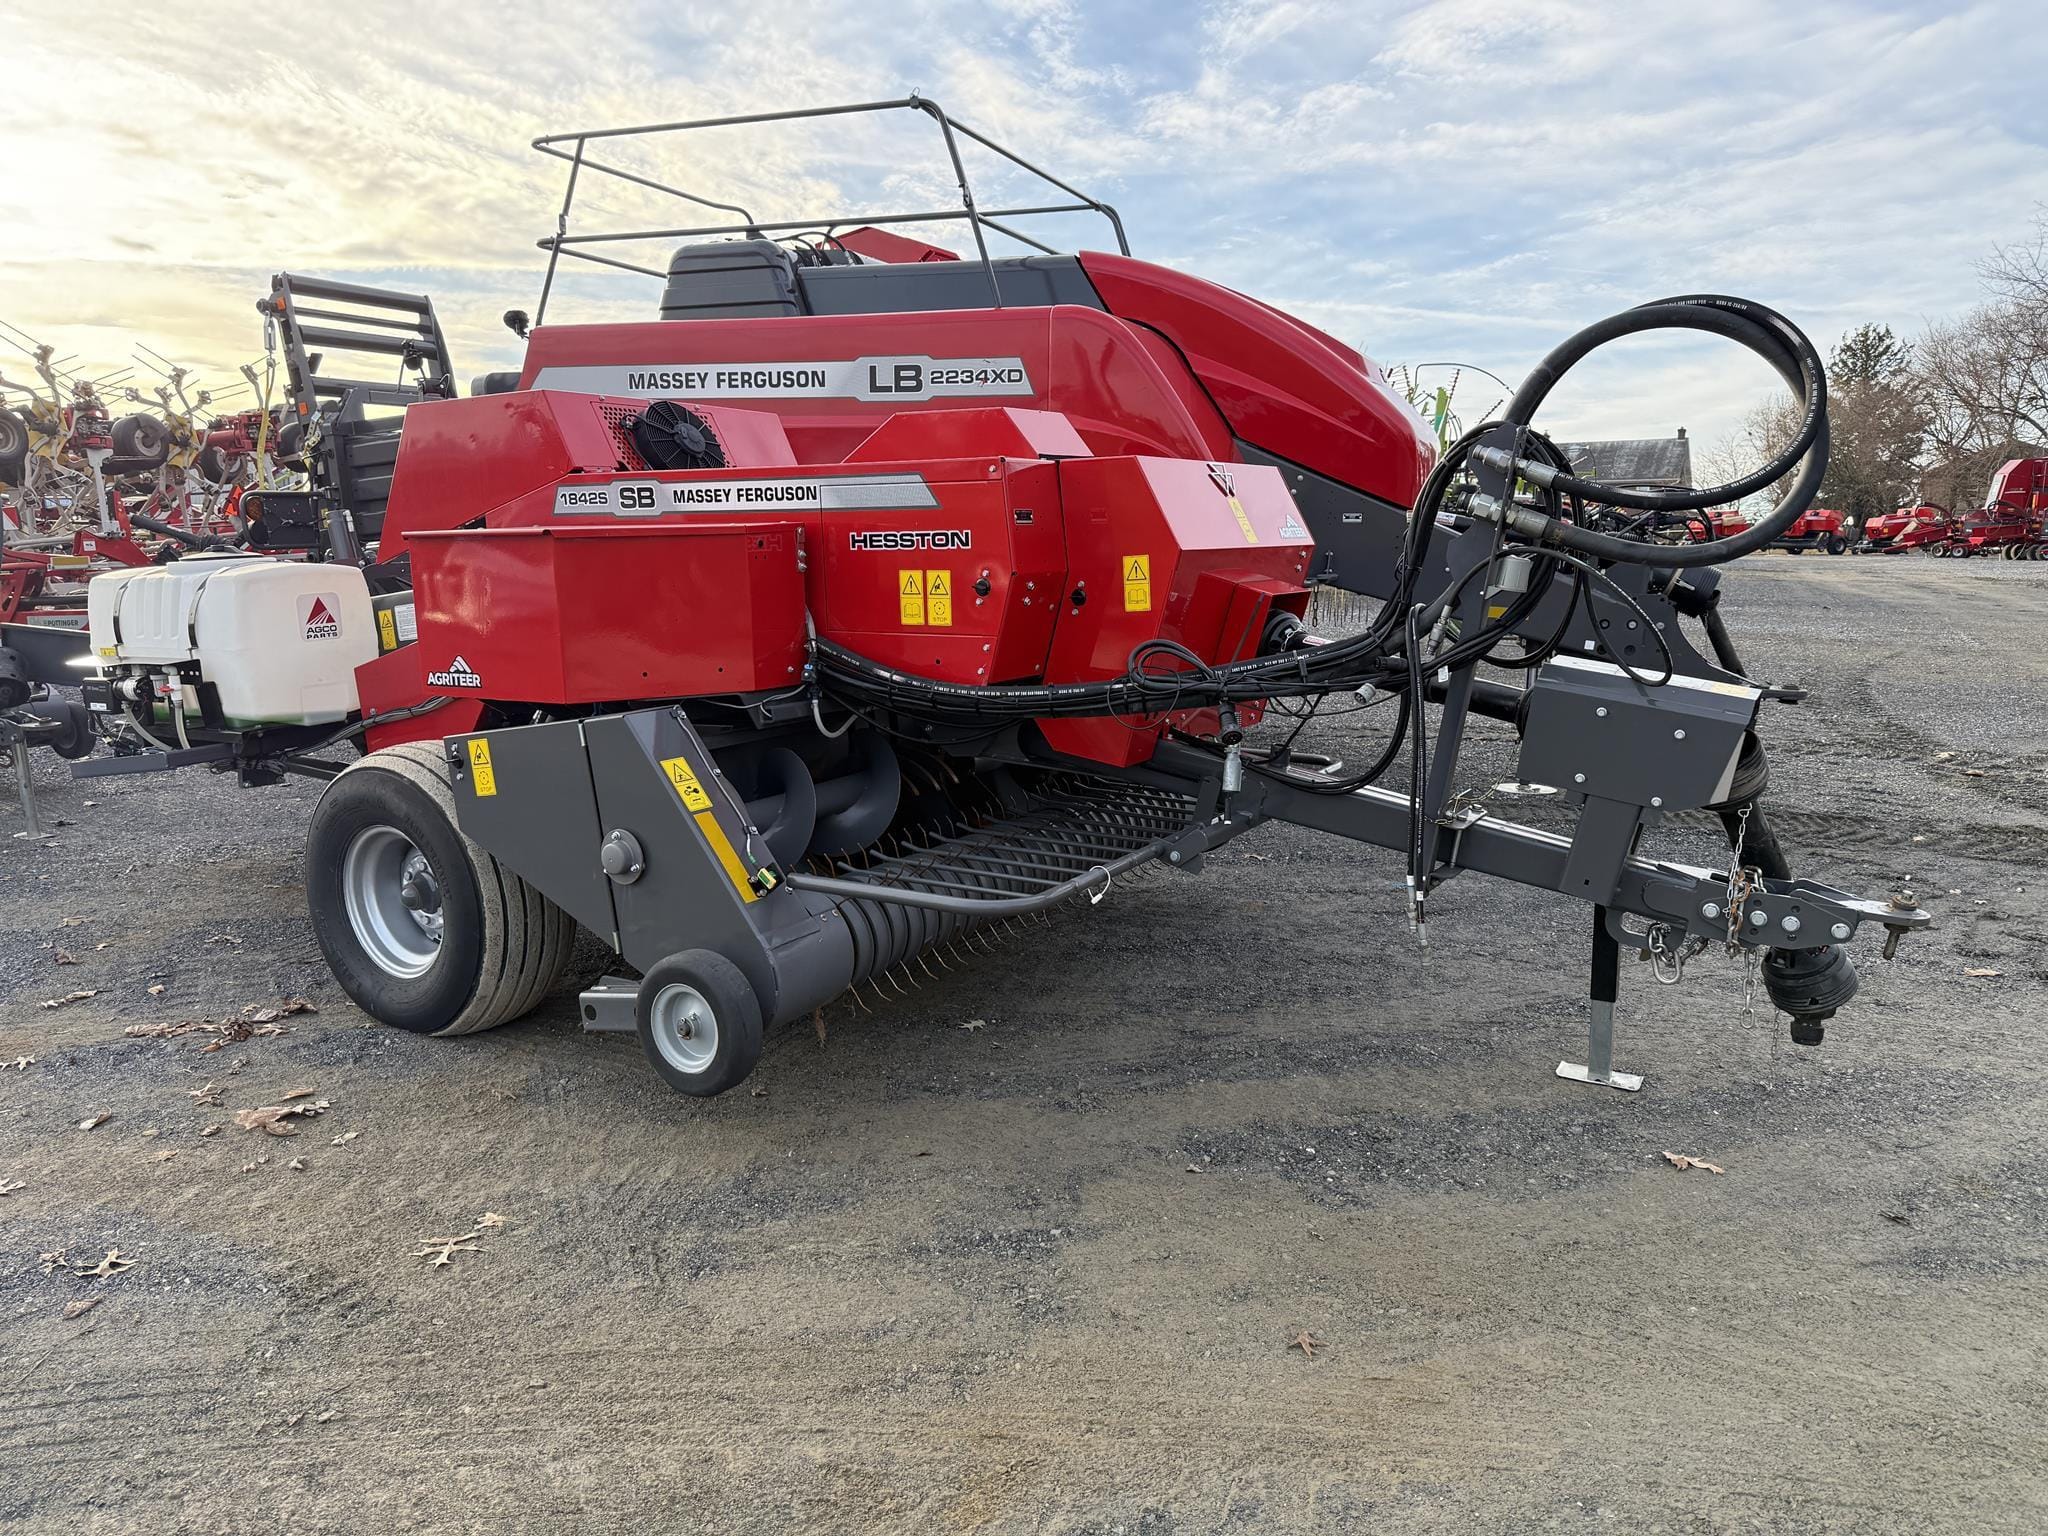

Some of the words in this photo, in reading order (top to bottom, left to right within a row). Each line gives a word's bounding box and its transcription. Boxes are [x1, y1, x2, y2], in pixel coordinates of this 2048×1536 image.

[628, 371, 709, 390] MASSEY
[716, 370, 826, 389] FERGUSON
[868, 364, 923, 393] LB
[929, 368, 1024, 385] 2234XD
[559, 491, 609, 505] 1842S
[618, 487, 656, 508] SB
[673, 488, 731, 503] MASSEY
[736, 486, 818, 502] FERGUSON
[849, 530, 971, 550] HESSTON
[306, 624, 338, 635] AGCO
[306, 631, 338, 640] PARTS
[427, 671, 482, 688] AGRITEER
